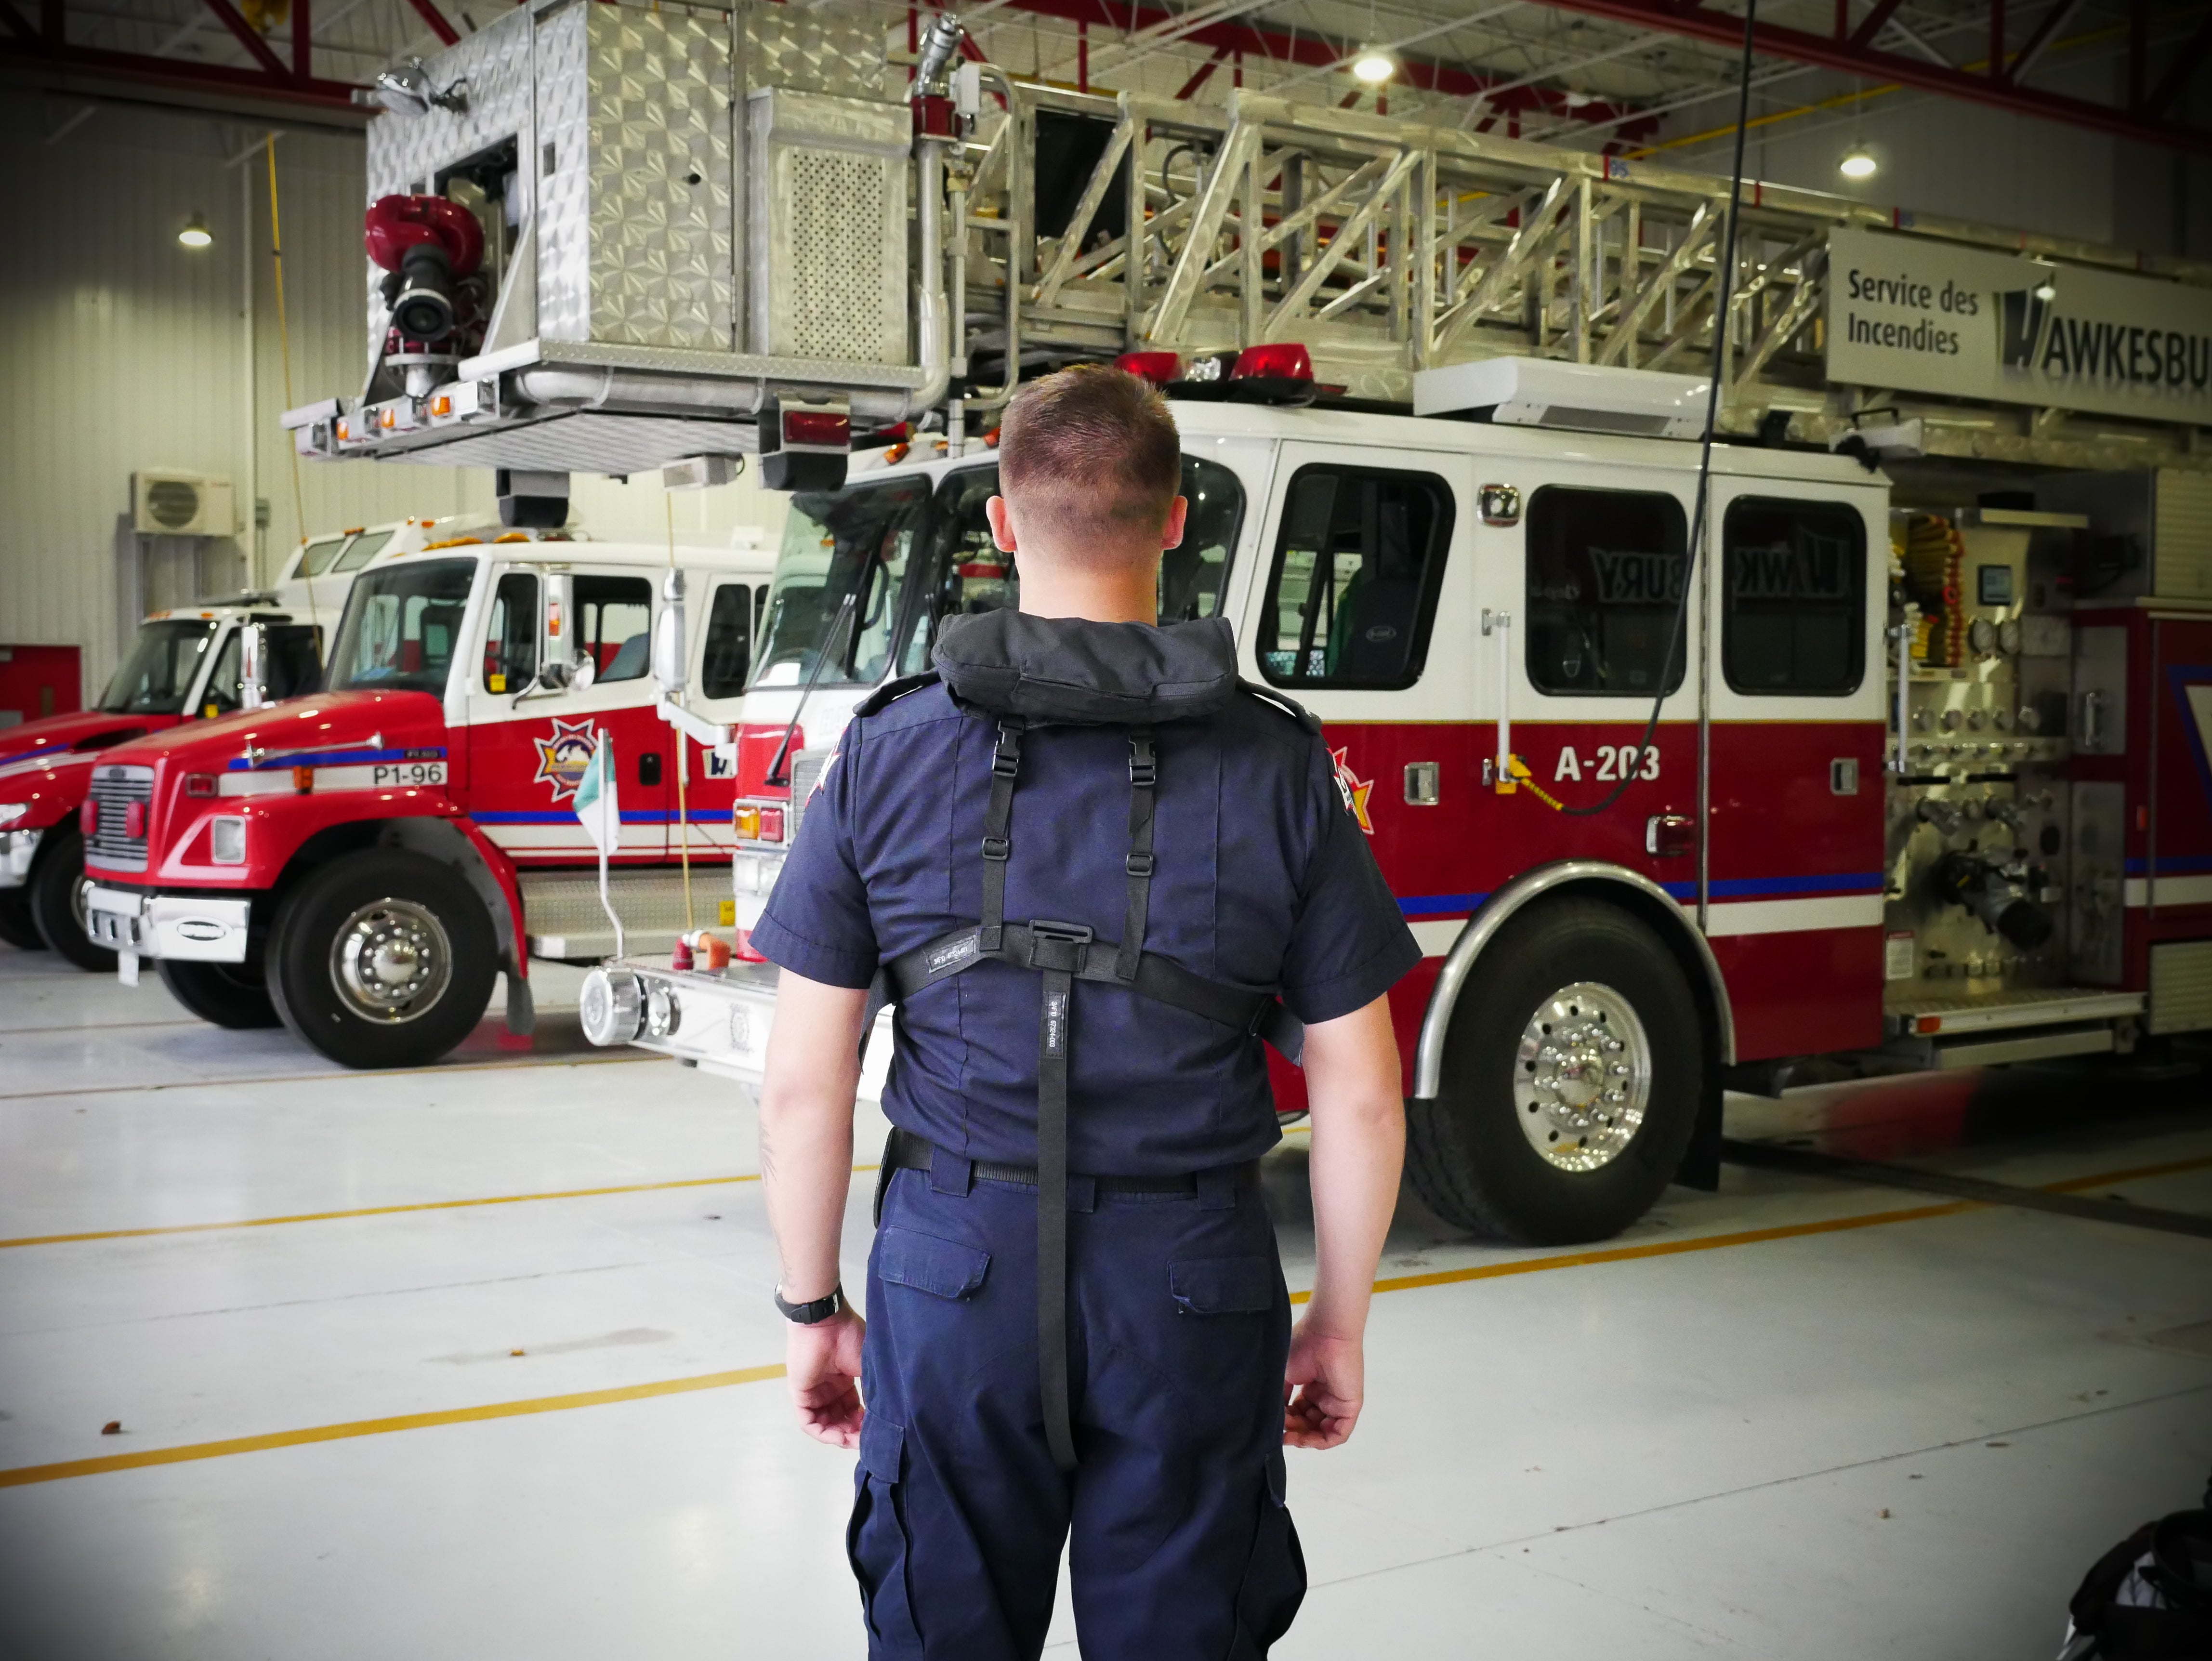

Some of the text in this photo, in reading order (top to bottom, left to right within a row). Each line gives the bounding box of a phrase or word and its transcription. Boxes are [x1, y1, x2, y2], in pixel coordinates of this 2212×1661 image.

[1848, 268, 1978, 316] Service des
[1848, 312, 1959, 355] Incendies
[374, 764, 442, 784] P1-96
[1554, 745, 1660, 781] A-203
